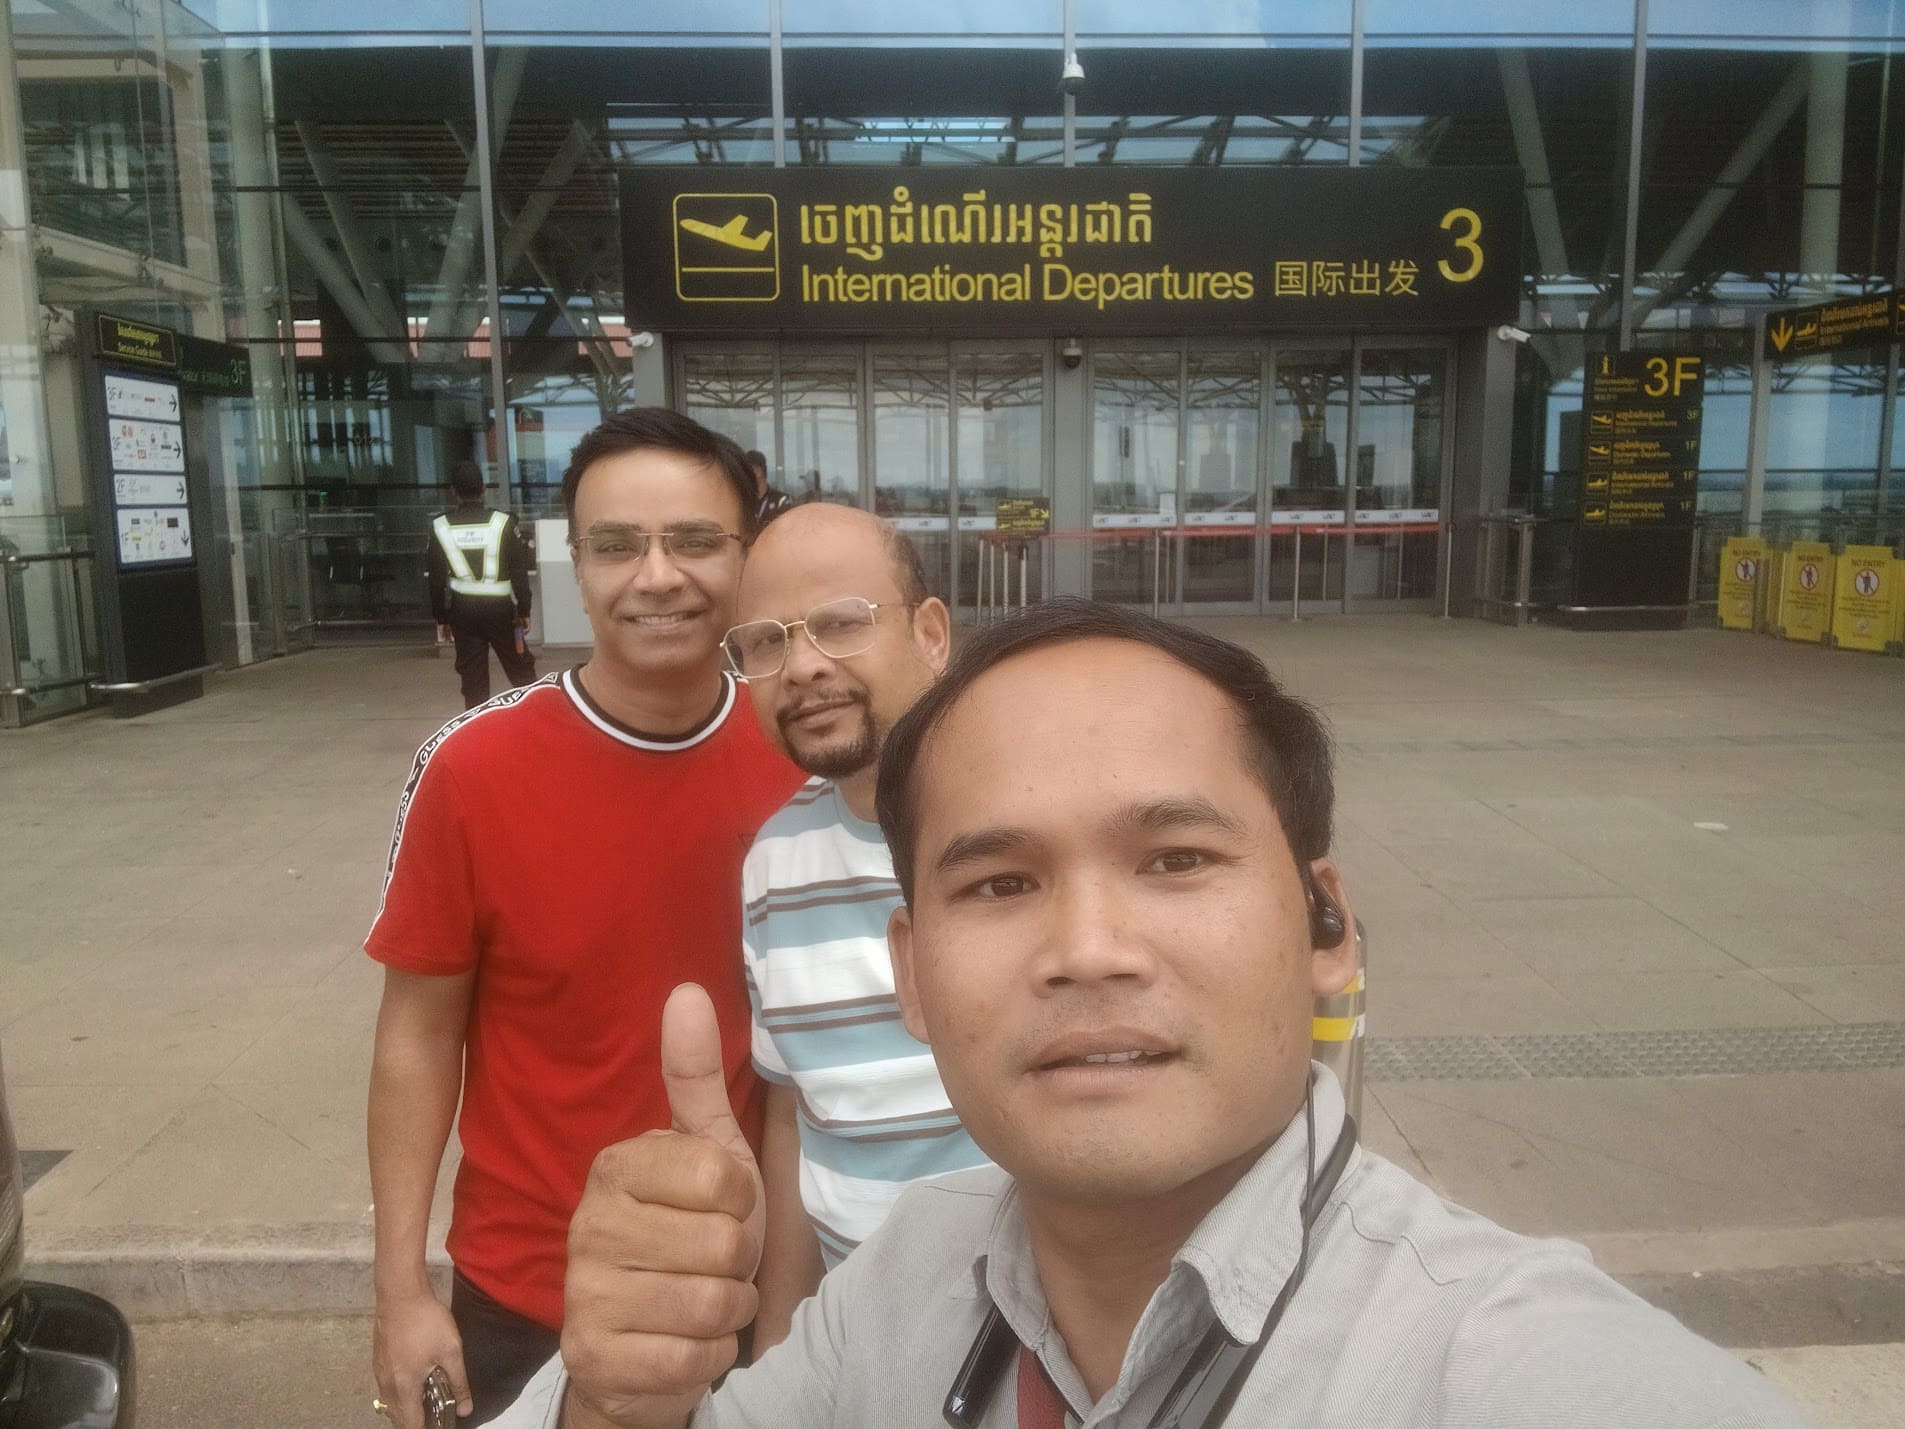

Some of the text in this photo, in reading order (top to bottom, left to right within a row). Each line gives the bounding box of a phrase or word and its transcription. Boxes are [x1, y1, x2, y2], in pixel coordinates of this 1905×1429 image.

[1438, 207, 1484, 283] 3
[801, 263, 1254, 311] International Departures
[1274, 259, 1420, 297] 国际出发
[1644, 356, 1701, 397] 3F
